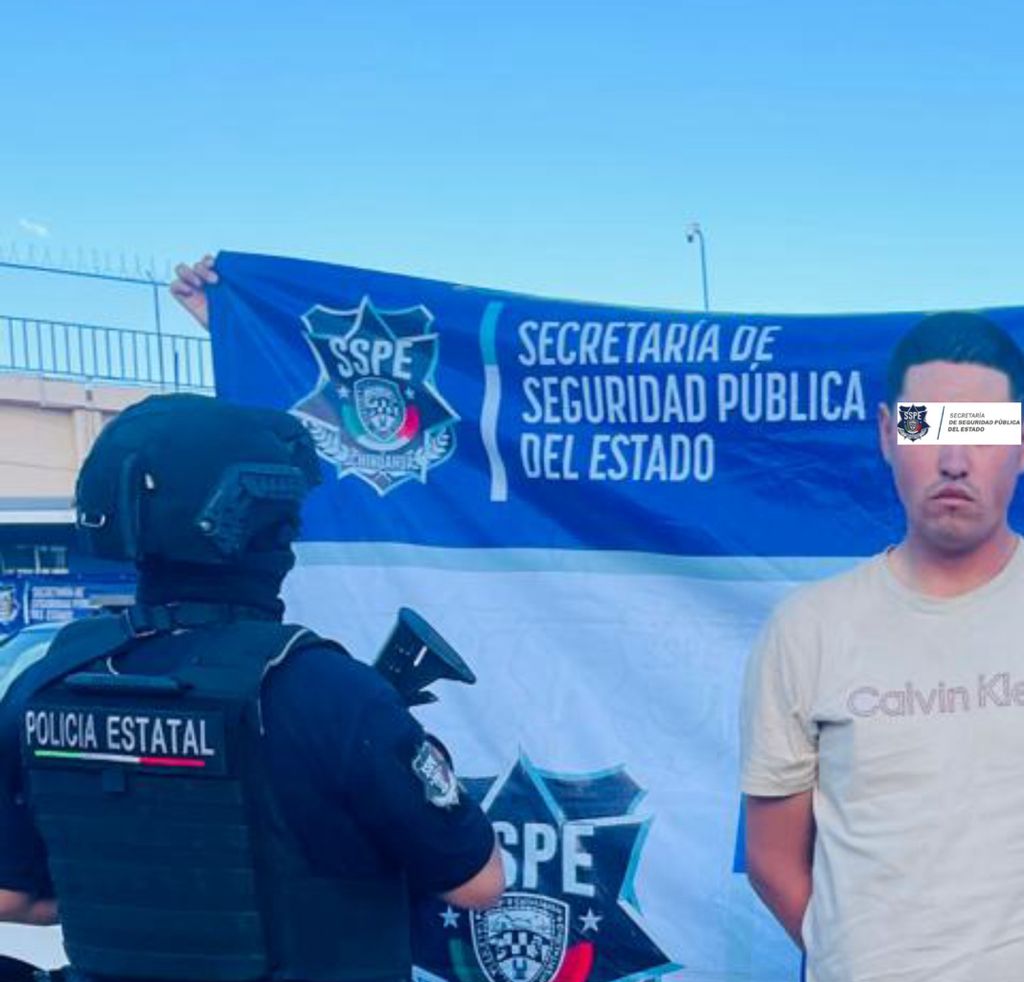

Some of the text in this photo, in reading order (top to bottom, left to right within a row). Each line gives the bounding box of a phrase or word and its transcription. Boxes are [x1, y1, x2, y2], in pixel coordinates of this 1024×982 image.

[329, 337, 414, 380] SSPE
[518, 318, 783, 367] SECRETARÍA DE
[521, 362, 866, 425] SEGURIDAD PÚBLICA
[520, 432, 716, 482] DEL ESTADO
[848, 680, 969, 718] Calvin
[106, 715, 215, 756] ESTATAL
[494, 821, 596, 897] SPE
